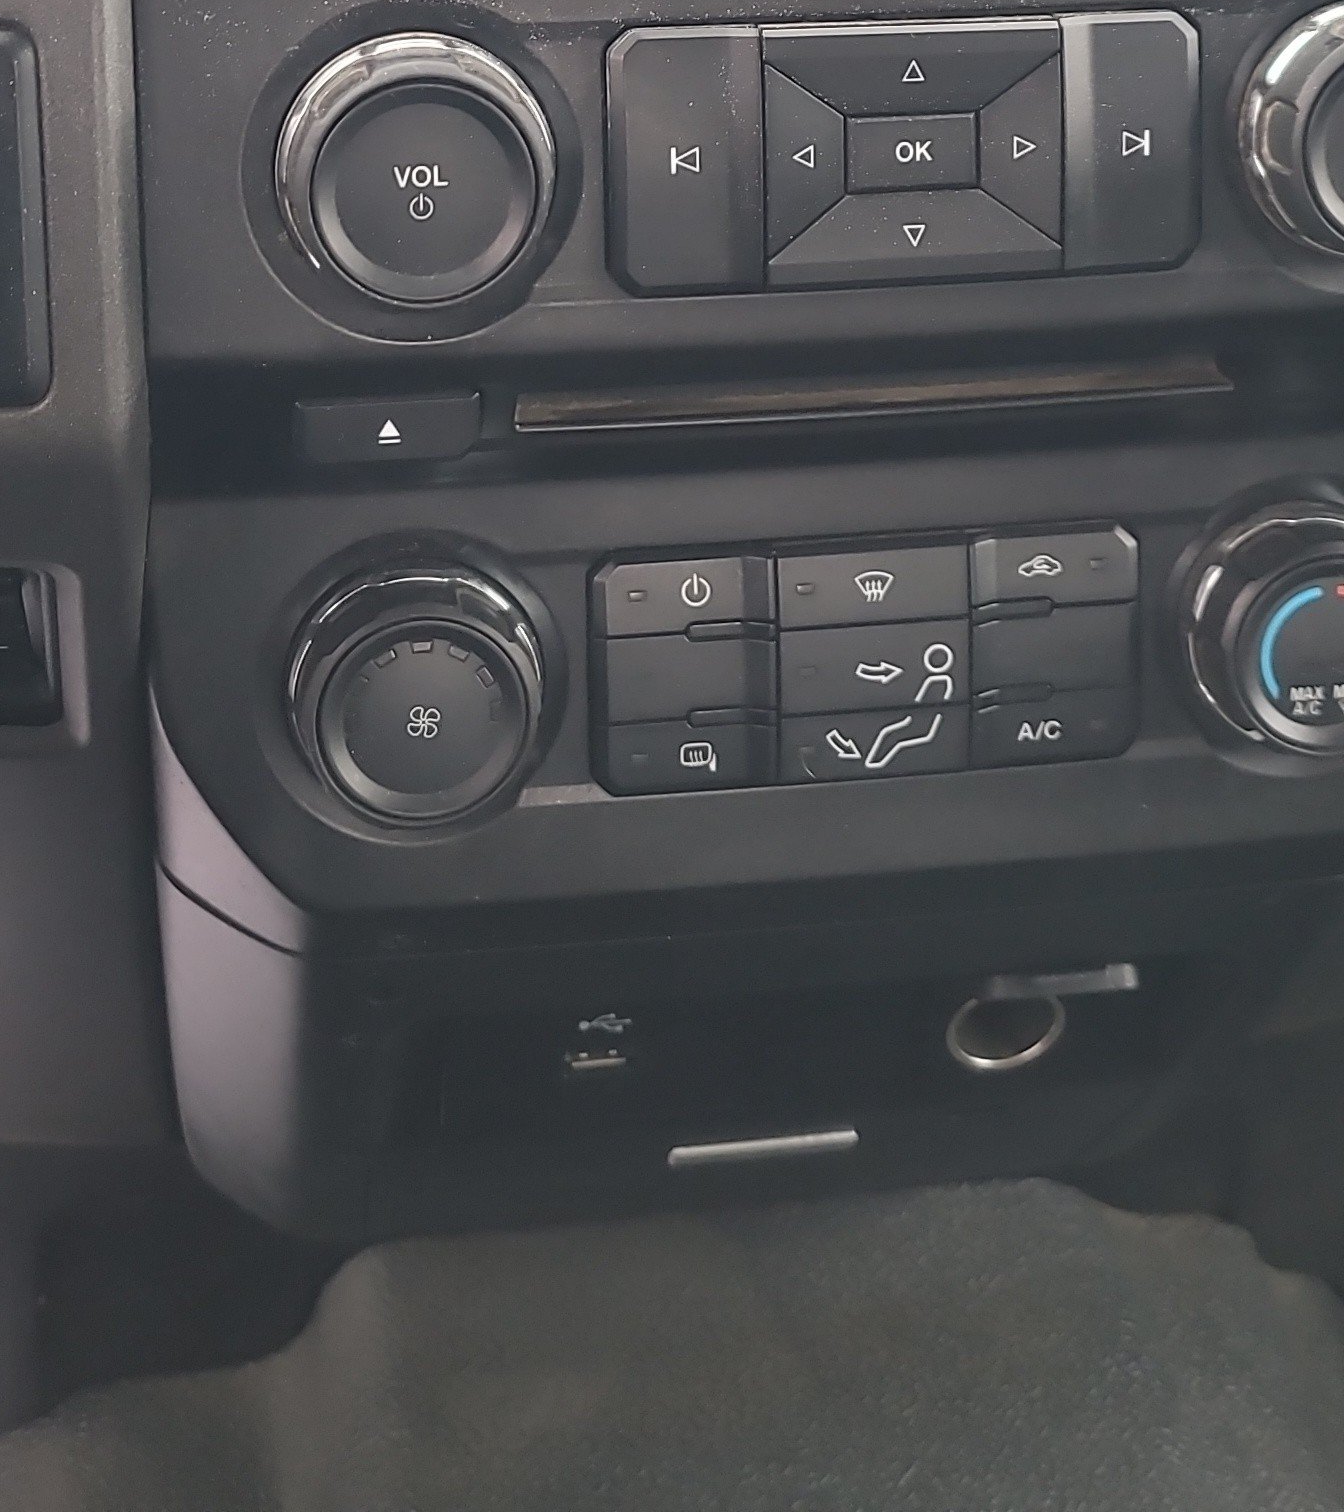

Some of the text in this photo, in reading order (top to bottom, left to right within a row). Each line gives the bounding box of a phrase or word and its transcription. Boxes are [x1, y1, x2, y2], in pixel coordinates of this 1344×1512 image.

[894, 141, 933, 163] OK
[393, 165, 449, 189] VOL
[1289, 686, 1325, 701] MAX
[1016, 719, 1063, 743] A/C
